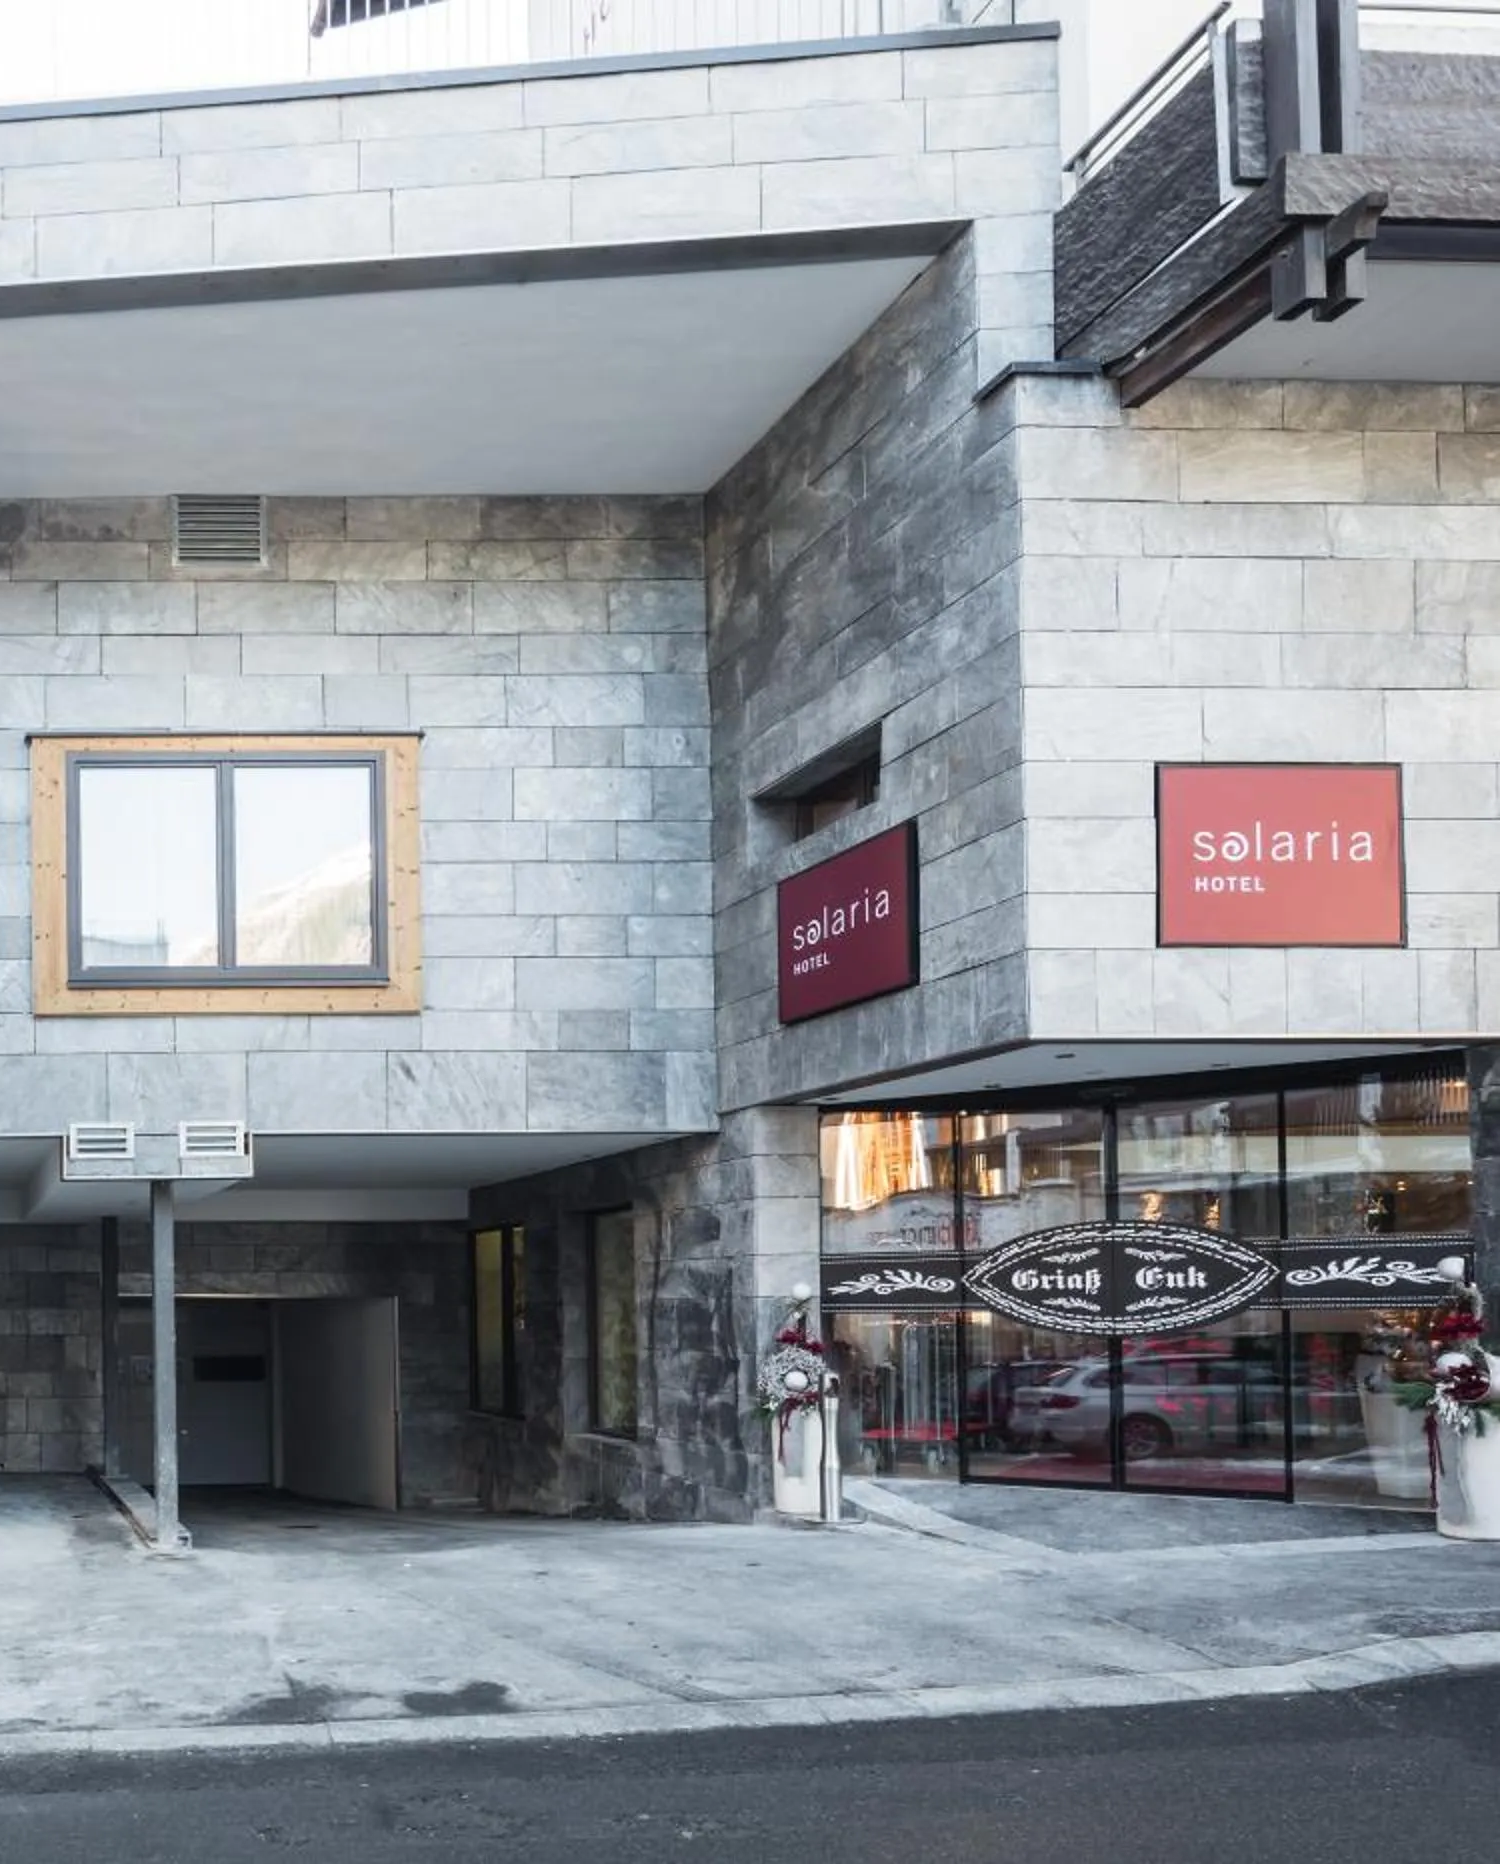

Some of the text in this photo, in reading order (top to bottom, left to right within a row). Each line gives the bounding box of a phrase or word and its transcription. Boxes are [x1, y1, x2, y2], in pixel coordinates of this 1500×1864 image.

[1193, 820, 1373, 862] solaria
[1194, 875, 1266, 893] HOTEL
[793, 887, 890, 951] solaria
[793, 951, 831, 976] HOTEL
